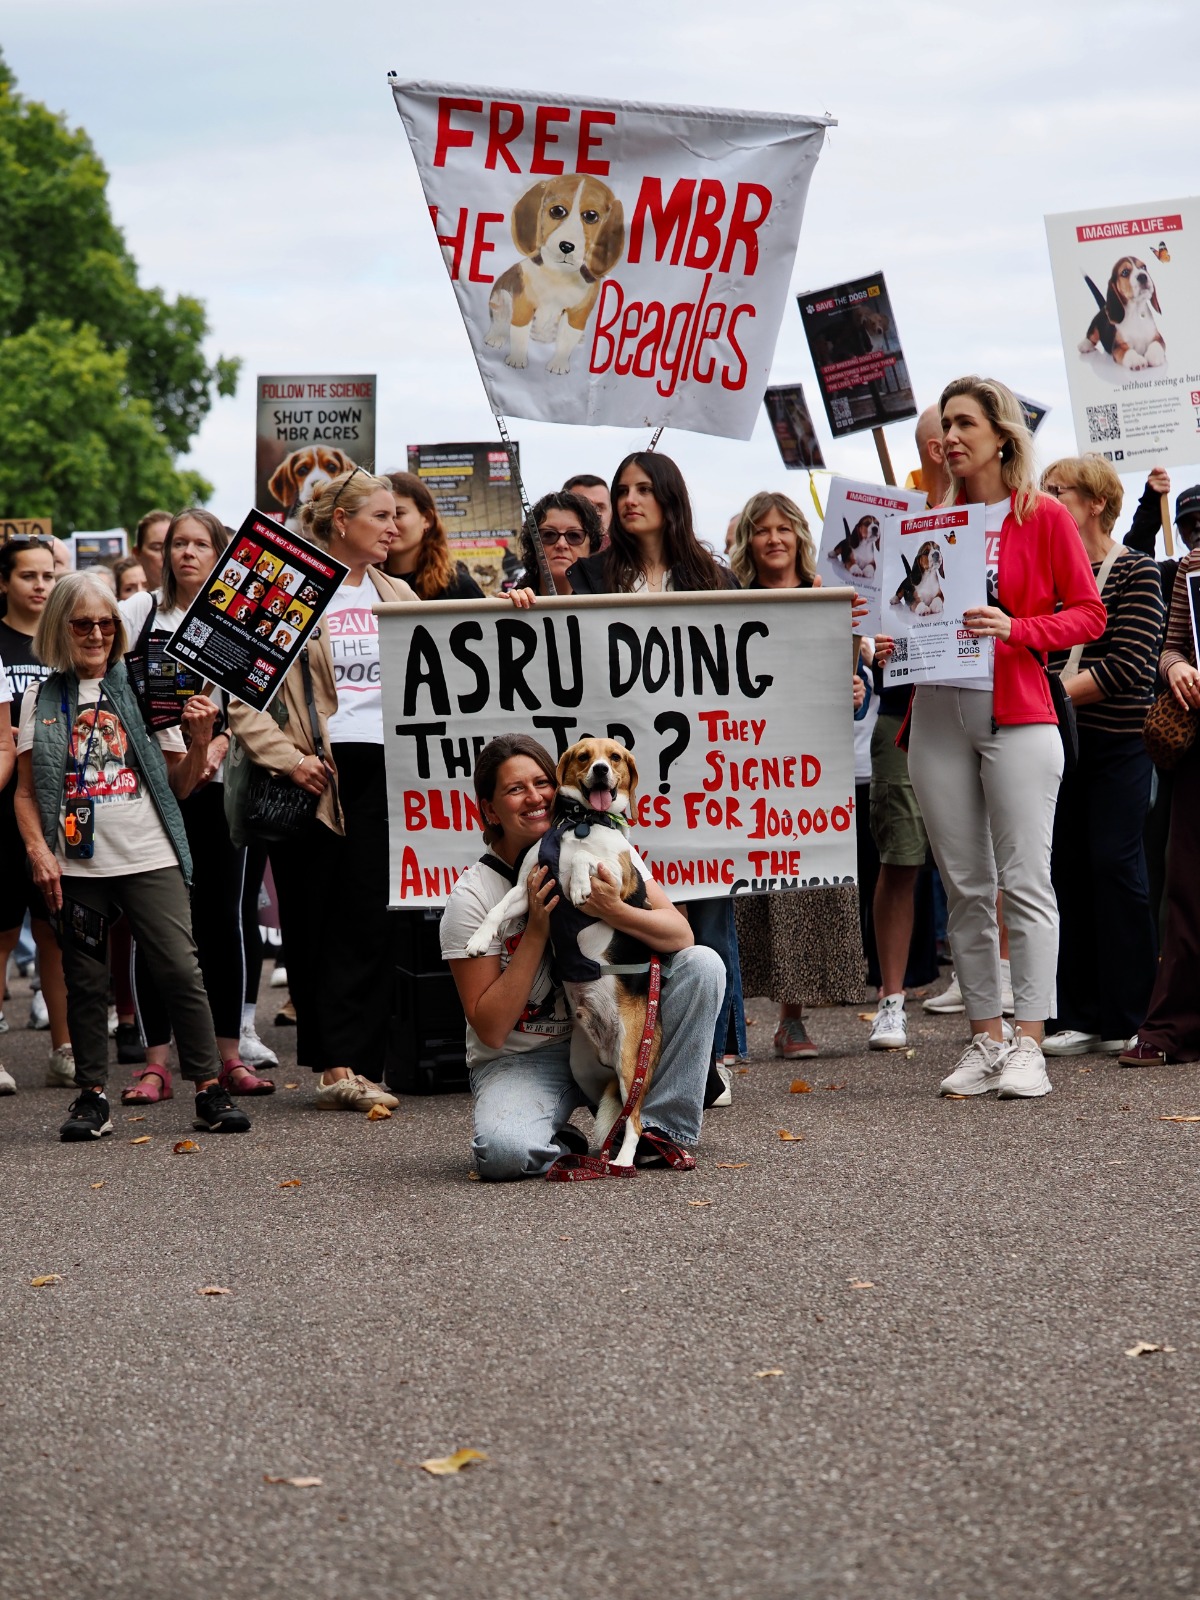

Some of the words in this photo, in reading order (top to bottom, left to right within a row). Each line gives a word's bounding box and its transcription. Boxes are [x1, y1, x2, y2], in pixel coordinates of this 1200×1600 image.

[434, 98, 615, 176] FREE
[430, 206, 504, 283] HE
[627, 177, 773, 276] MBR
[1082, 222, 1130, 239] IMAGINE
[1131, 222, 1140, 233] A
[1141, 219, 1164, 232] LIFE
[815, 301, 834, 312] SAVE
[834, 297, 848, 306] THE
[848, 291, 868, 302] DOGS
[589, 273, 756, 397] Beagles
[262, 384, 304, 399] FOLLOW
[307, 384, 327, 398] THE
[330, 383, 372, 398] SCIENCE
[1122, 380, 1152, 391] without
[1153, 376, 1178, 388] seeing
[274, 410, 313, 425] SHUT
[318, 407, 362, 423] DOWN
[277, 426, 308, 441] MBR
[313, 425, 360, 441] ACRES
[849, 492, 876, 505] IMAGINE
[884, 499, 898, 509] LIFE
[904, 519, 933, 531] IMAGINE
[934, 518, 940, 526] A
[941, 515, 956, 525] LIFE
[256, 524, 266, 534] WE
[265, 530, 277, 541] ARE
[275, 536, 287, 547] NOT
[286, 543, 301, 556] JUST
[300, 552, 327, 572] NUMBERS
[223, 619, 232, 627] are
[232, 624, 252, 641] waiting
[257, 641, 271, 652] come
[270, 648, 285, 661] home
[330, 639, 372, 657] THE
[958, 647, 980, 655] DOGS
[12, 664, 41, 675] TESTING
[252, 667, 264, 677] THE
[256, 659, 275, 675] SAVE
[334, 662, 381, 683] DOG
[403, 615, 584, 716] ASRU
[608, 621, 774, 698] DOING
[247, 672, 268, 689] DOGS
[699, 711, 767, 746] THEY
[702, 750, 822, 792] SIGNED
[684, 792, 743, 830] FOR
[748, 850, 801, 877] THE
